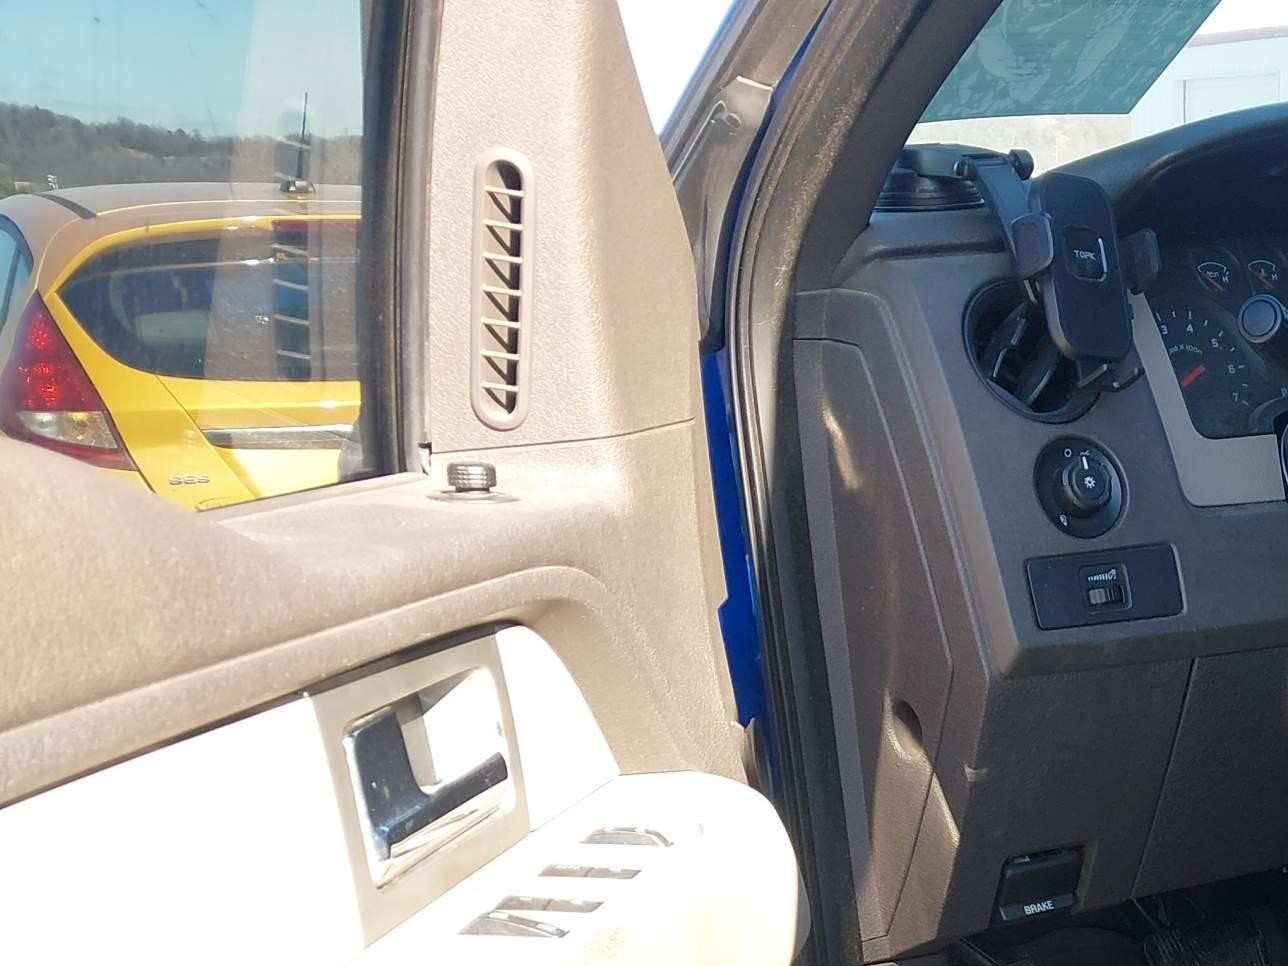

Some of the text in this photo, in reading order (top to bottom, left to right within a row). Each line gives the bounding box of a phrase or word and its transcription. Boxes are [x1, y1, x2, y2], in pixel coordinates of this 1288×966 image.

[1160, 324, 1169, 335] 3
[1186, 323, 1194, 333] 4
[1211, 338, 1220, 349] 5
[1227, 364, 1237, 375] 6
[1232, 392, 1239, 402] 7
[168, 474, 211, 487] SES
[1023, 900, 1055, 916] BRAKE
